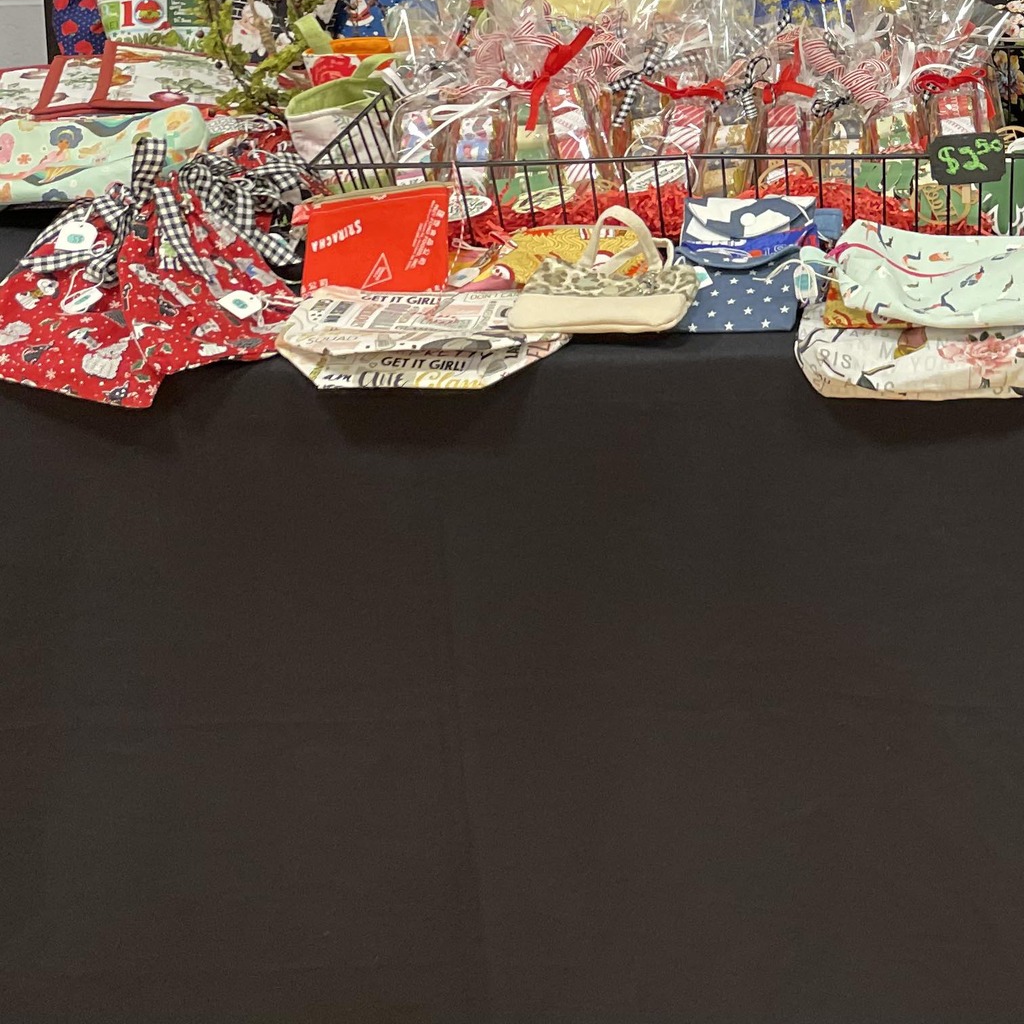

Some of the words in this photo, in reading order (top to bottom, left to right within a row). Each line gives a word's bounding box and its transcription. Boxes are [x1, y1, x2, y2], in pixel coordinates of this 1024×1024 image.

[311, 219, 362, 252] SRIRACHA
[361, 295, 387, 303] GET
[389, 295, 403, 303] IT
[381, 356, 410, 368] GET
[411, 358, 426, 369] IT
[429, 359, 466, 372] GIRL!
